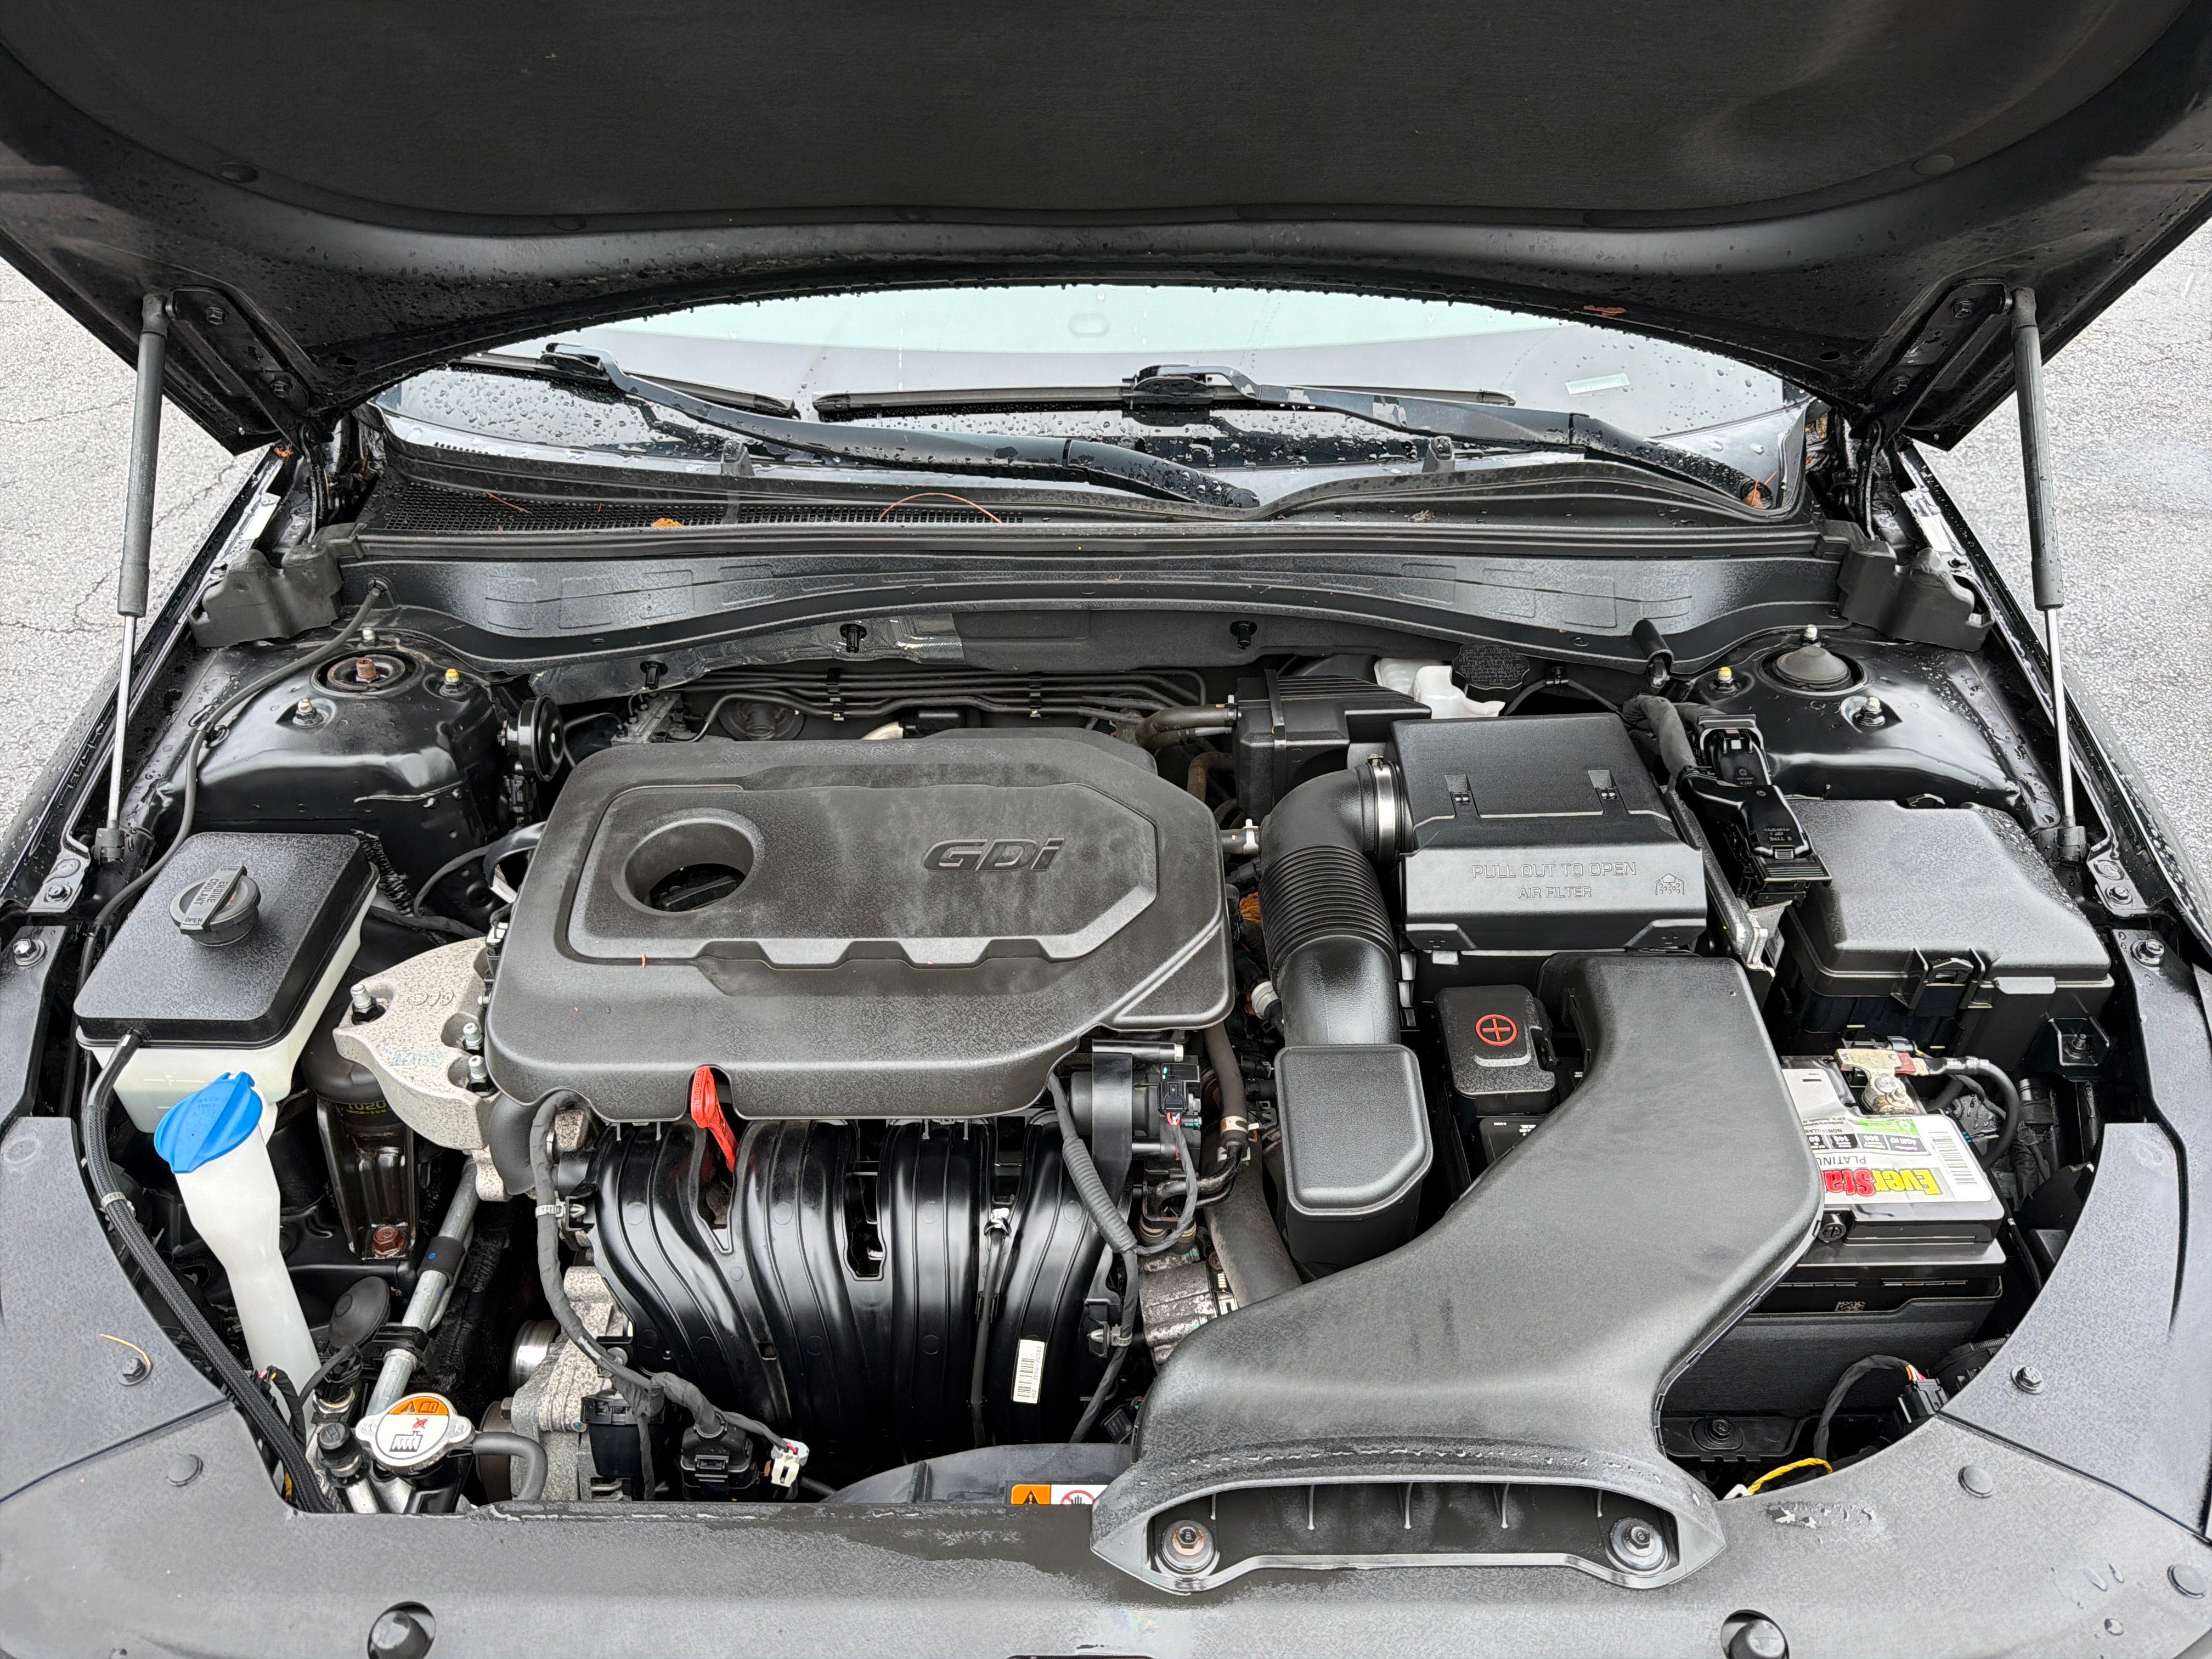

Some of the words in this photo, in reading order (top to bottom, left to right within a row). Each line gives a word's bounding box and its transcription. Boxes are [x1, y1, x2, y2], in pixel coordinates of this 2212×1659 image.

[924, 837, 1065, 871] GDi
[1472, 865, 1516, 878] PULL
[1520, 864, 1556, 878] OUT
[1560, 863, 1584, 877] TO
[1589, 862, 1637, 877] OPEN
[194, 878, 220, 906] COOLANT
[1518, 887, 1542, 899] AIR
[1545, 886, 1592, 899] FILTER
[1823, 1169, 1943, 1196] EverSta
